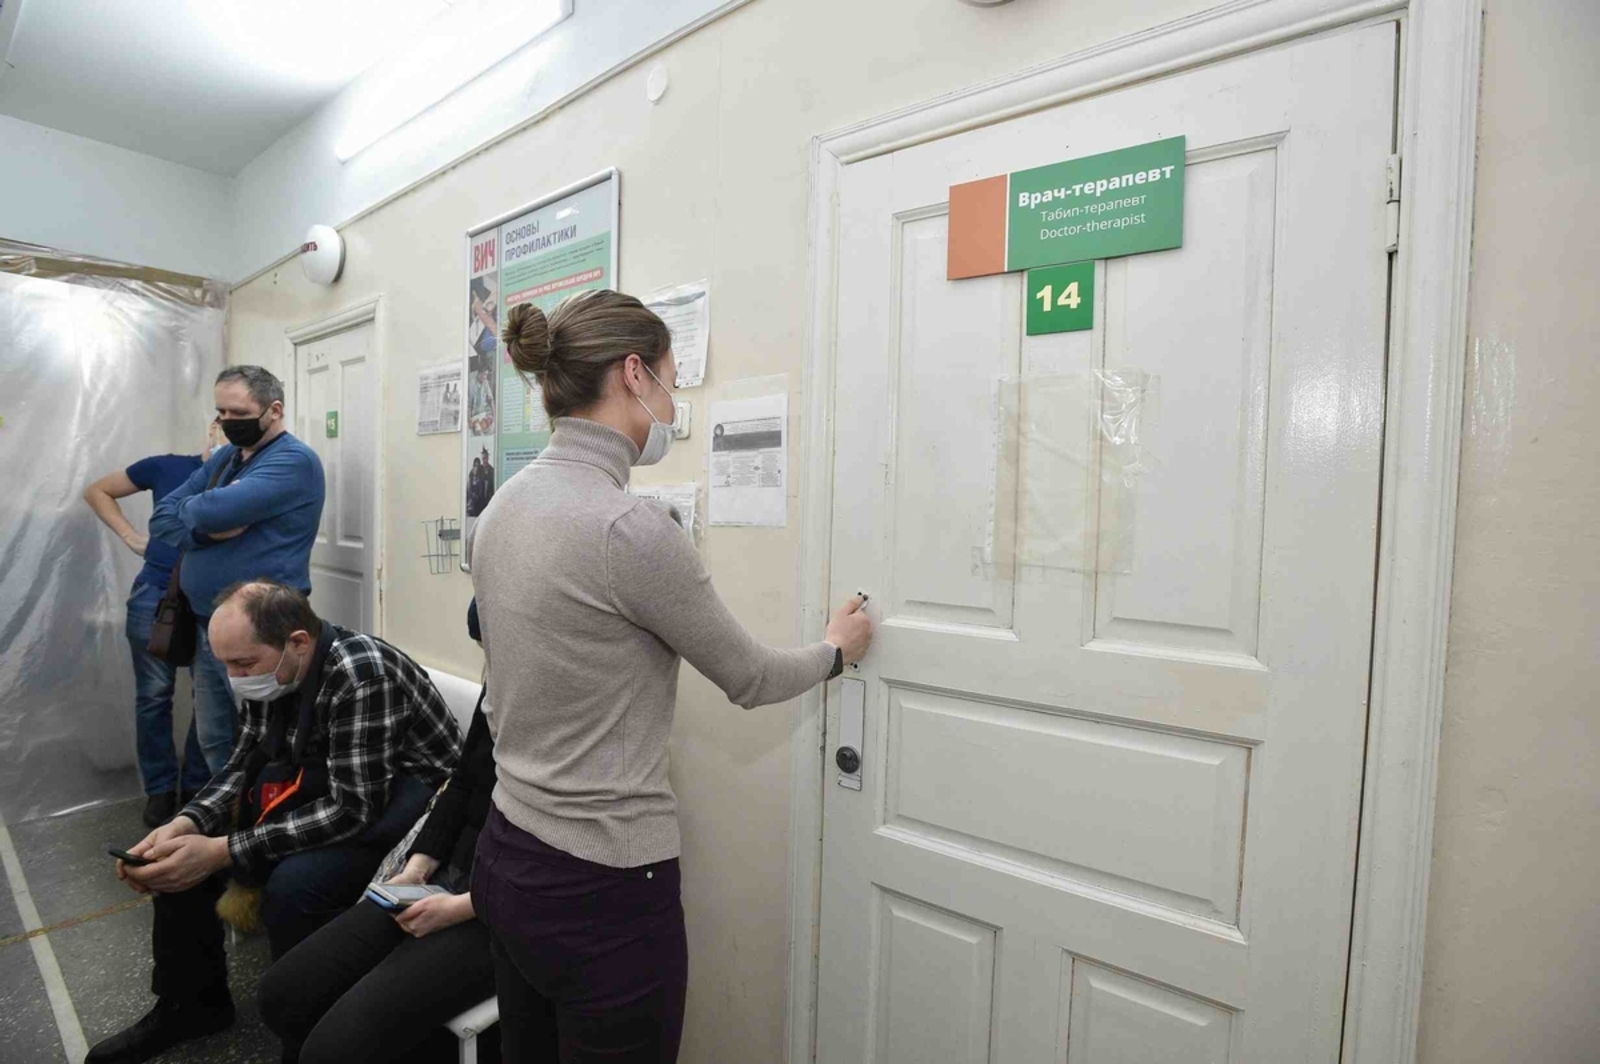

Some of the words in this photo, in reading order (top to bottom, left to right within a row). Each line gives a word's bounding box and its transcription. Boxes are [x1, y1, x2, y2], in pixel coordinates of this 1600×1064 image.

[1018, 164, 1175, 208] Врач-терапевт
[1040, 194, 1147, 222] Табип-терапевт
[505, 220, 540, 245] ОСНОВЫ
[1040, 212, 1146, 240] Doctor-therapist
[473, 238, 496, 273] ВИЧ
[505, 224, 577, 262] ПРОФИЛАКТИКИ
[1036, 282, 1081, 311] 14
